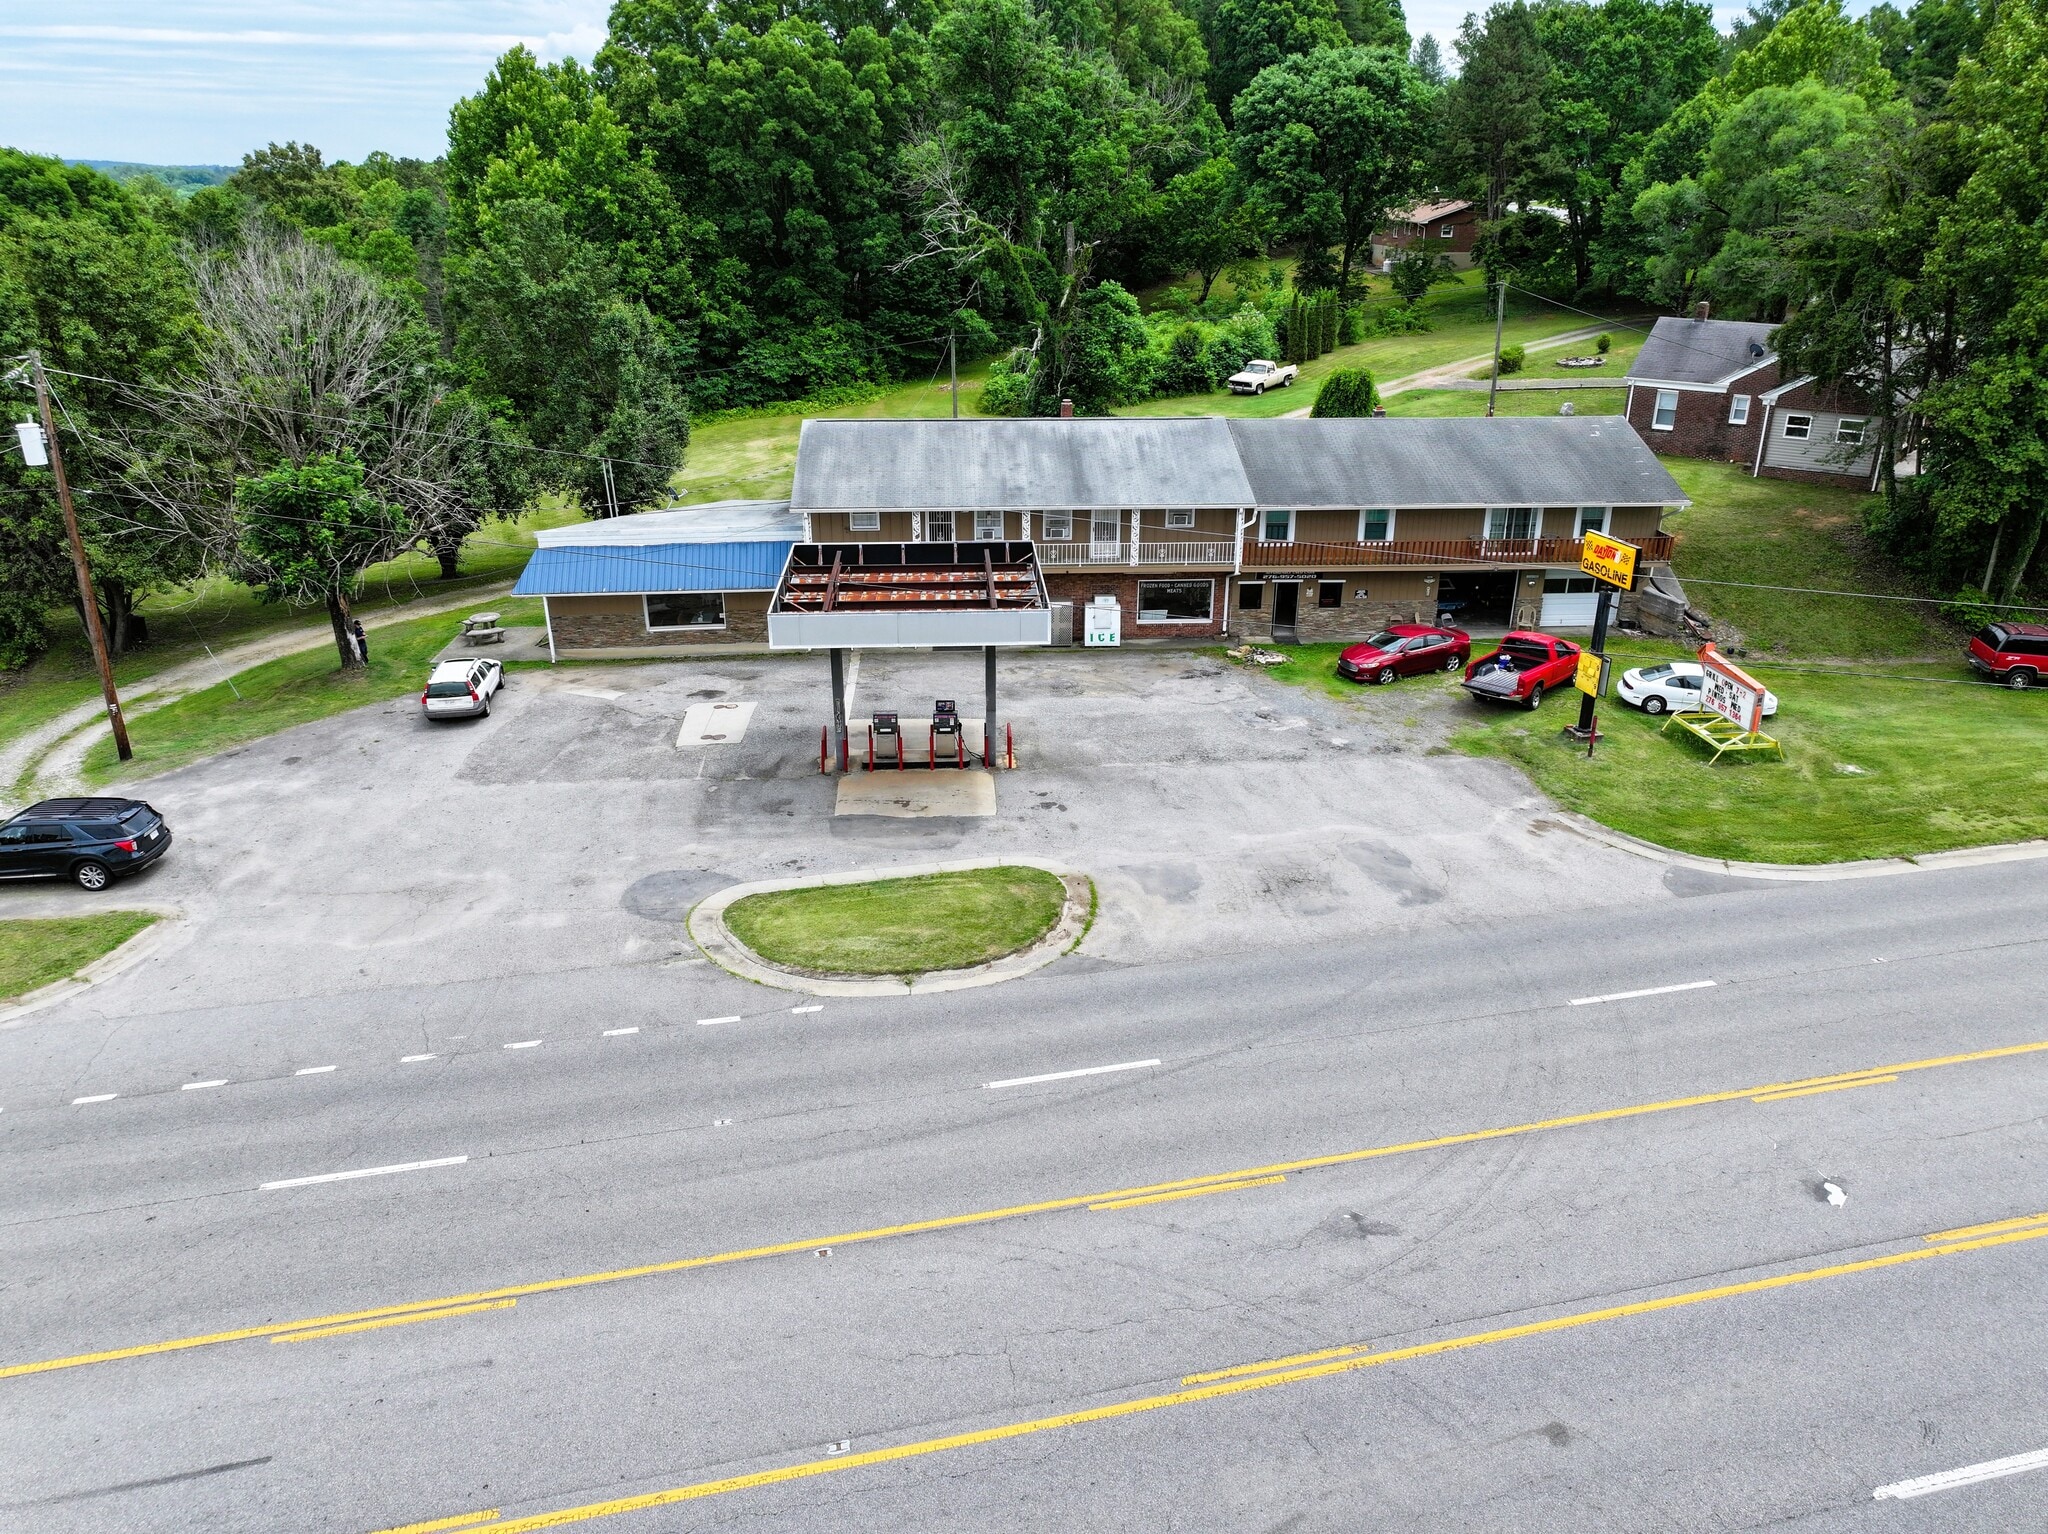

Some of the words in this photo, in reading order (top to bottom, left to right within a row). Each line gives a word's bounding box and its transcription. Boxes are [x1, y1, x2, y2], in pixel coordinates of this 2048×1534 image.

[1593, 545, 1620, 562] DAYTON
[1582, 558, 1628, 585] GASOLINE
[1090, 633, 1116, 642] ICE
[1705, 669, 1719, 683] GRILL
[1721, 679, 1733, 691] OPEN
[1705, 695, 1715, 706] 276
[1730, 702, 1741, 713] WED
